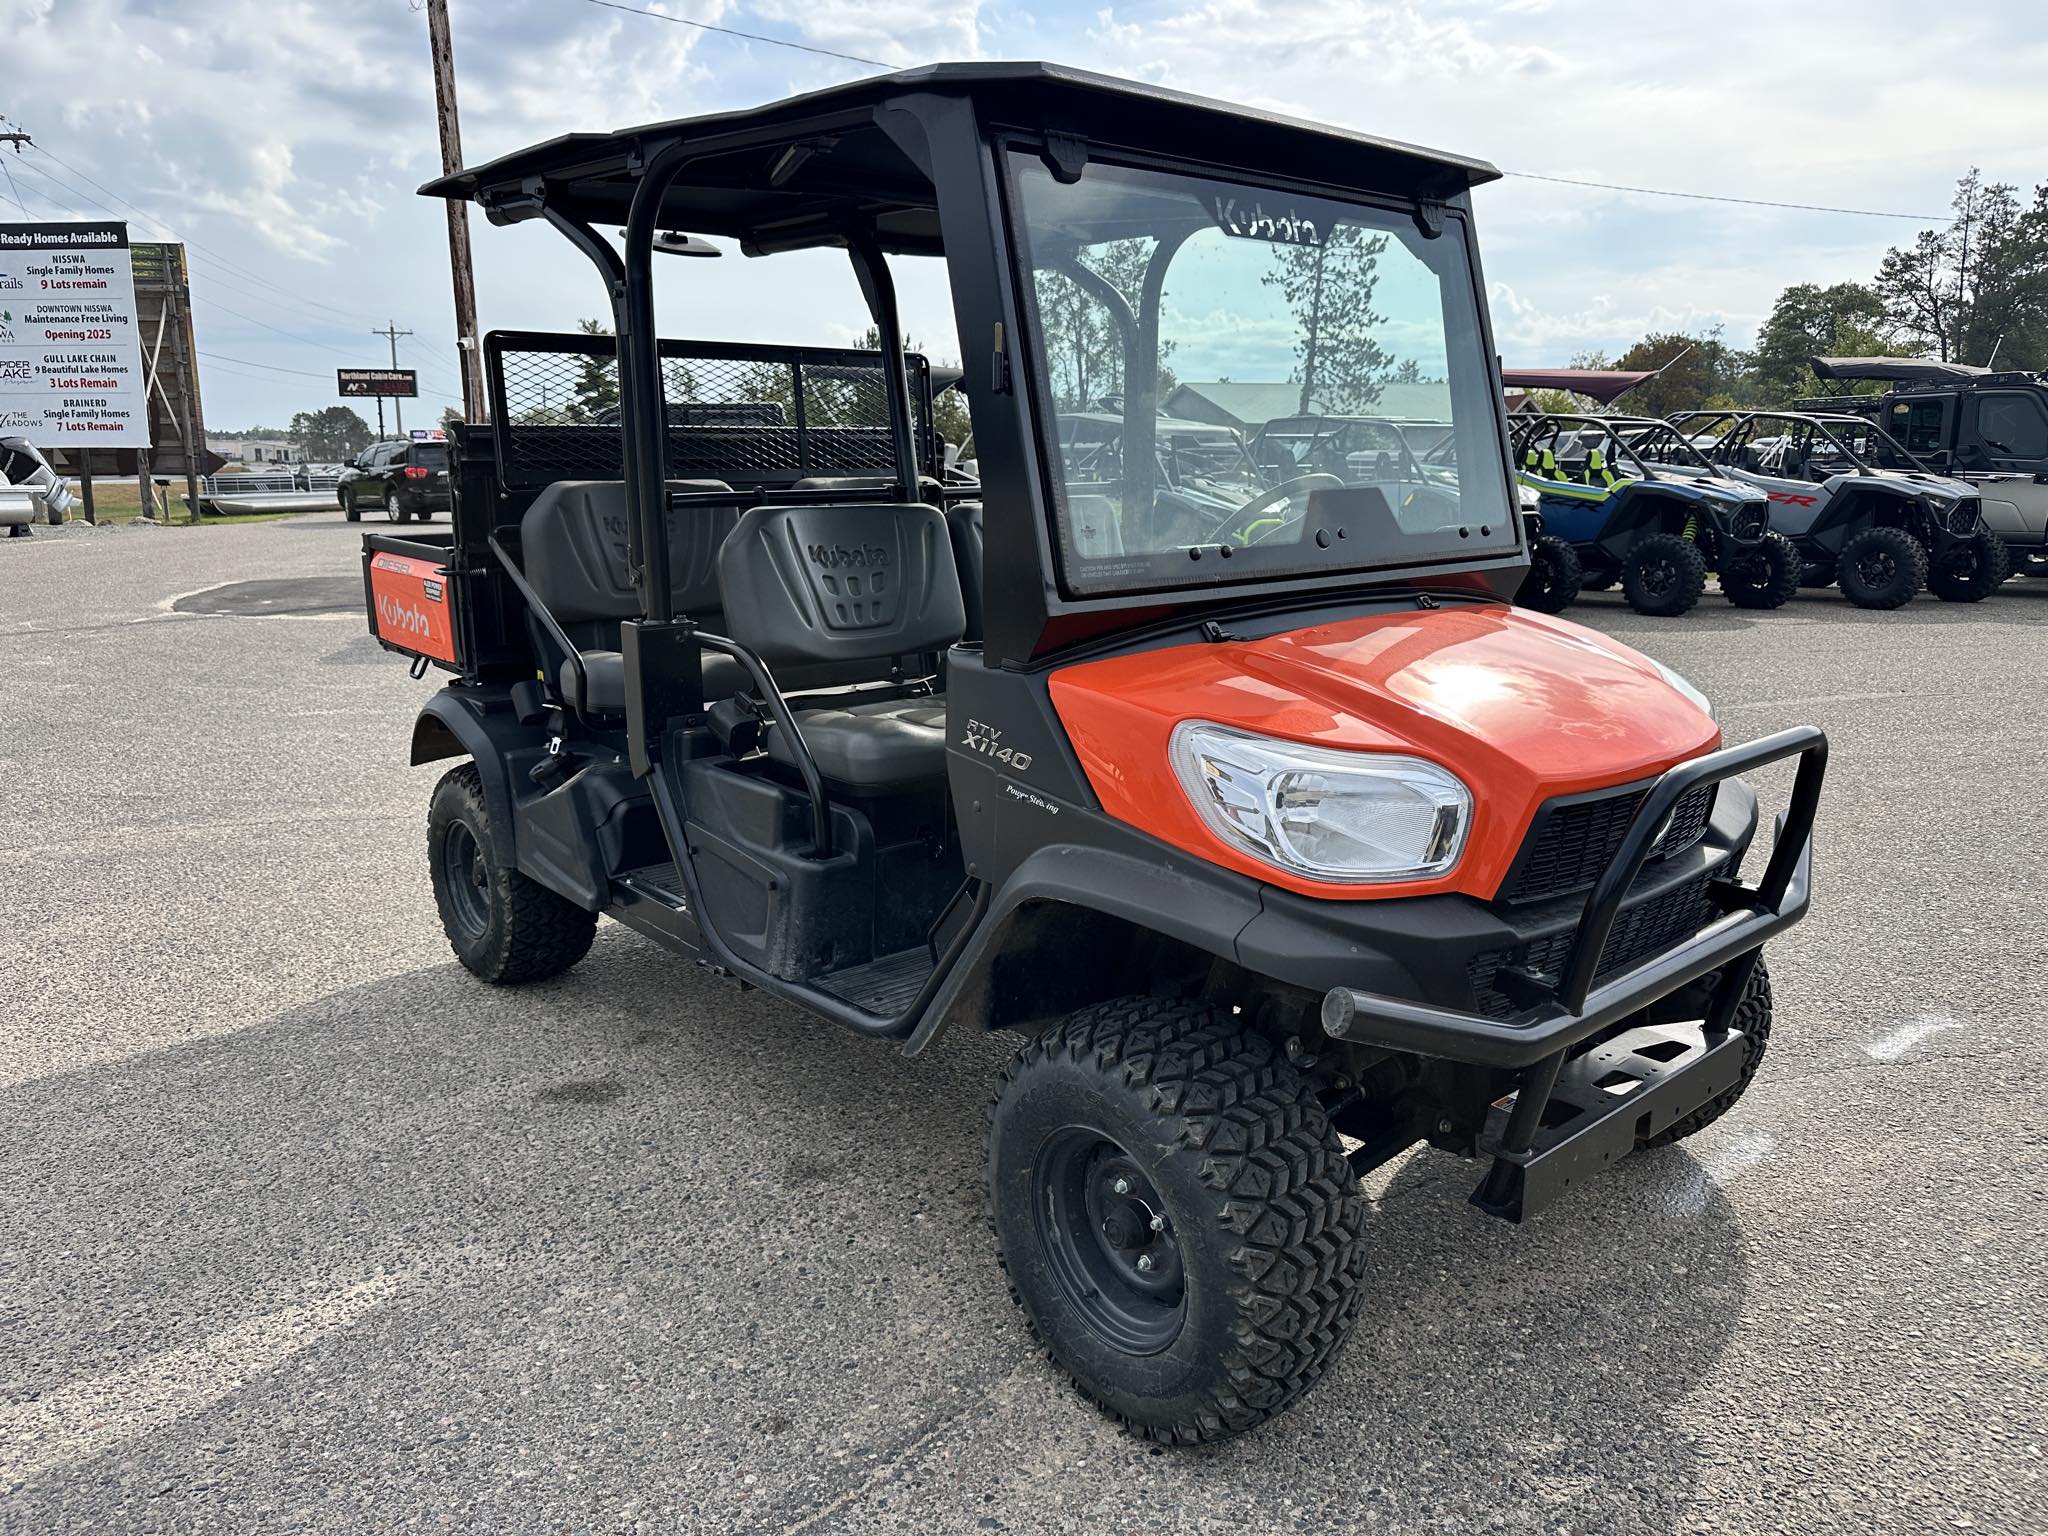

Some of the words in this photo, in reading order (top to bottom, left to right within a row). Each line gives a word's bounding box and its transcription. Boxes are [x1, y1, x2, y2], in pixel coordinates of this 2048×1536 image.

[1215, 196, 1322, 245] Kubota
[0, 233, 32, 246] Ready
[34, 233, 68, 243] Homes
[70, 232, 118, 243] Available
[52, 255, 85, 263] NISSWA
[27, 266, 53, 276] Single
[55, 266, 83, 276] Family
[85, 266, 114, 274] Homes
[41, 280, 47, 289] 9
[51, 280, 70, 289] Lots
[73, 279, 107, 288] remain
[37, 305, 82, 313] DOWNTOWN
[25, 315, 79, 323] Maintenance
[81, 315, 100, 323] Free
[102, 314, 128, 324] Living
[45, 329, 85, 341] Opening
[87, 330, 111, 339] 2025
[0, 369, 32, 378] AKE
[50, 379, 56, 387] 3
[58, 378, 78, 388] Lots
[80, 377, 117, 388] Remain
[64, 399, 106, 407] BRAINERD
[44, 409, 70, 420] Single
[72, 409, 99, 420] Family
[101, 410, 130, 418] Homes
[57, 423, 62, 431] 7
[66, 422, 86, 431] Lots
[88, 421, 123, 431] Remain
[807, 543, 889, 569] Kubota
[378, 592, 430, 637] Kubota
[966, 718, 1002, 740] RTV
[961, 730, 1033, 770] X1140
